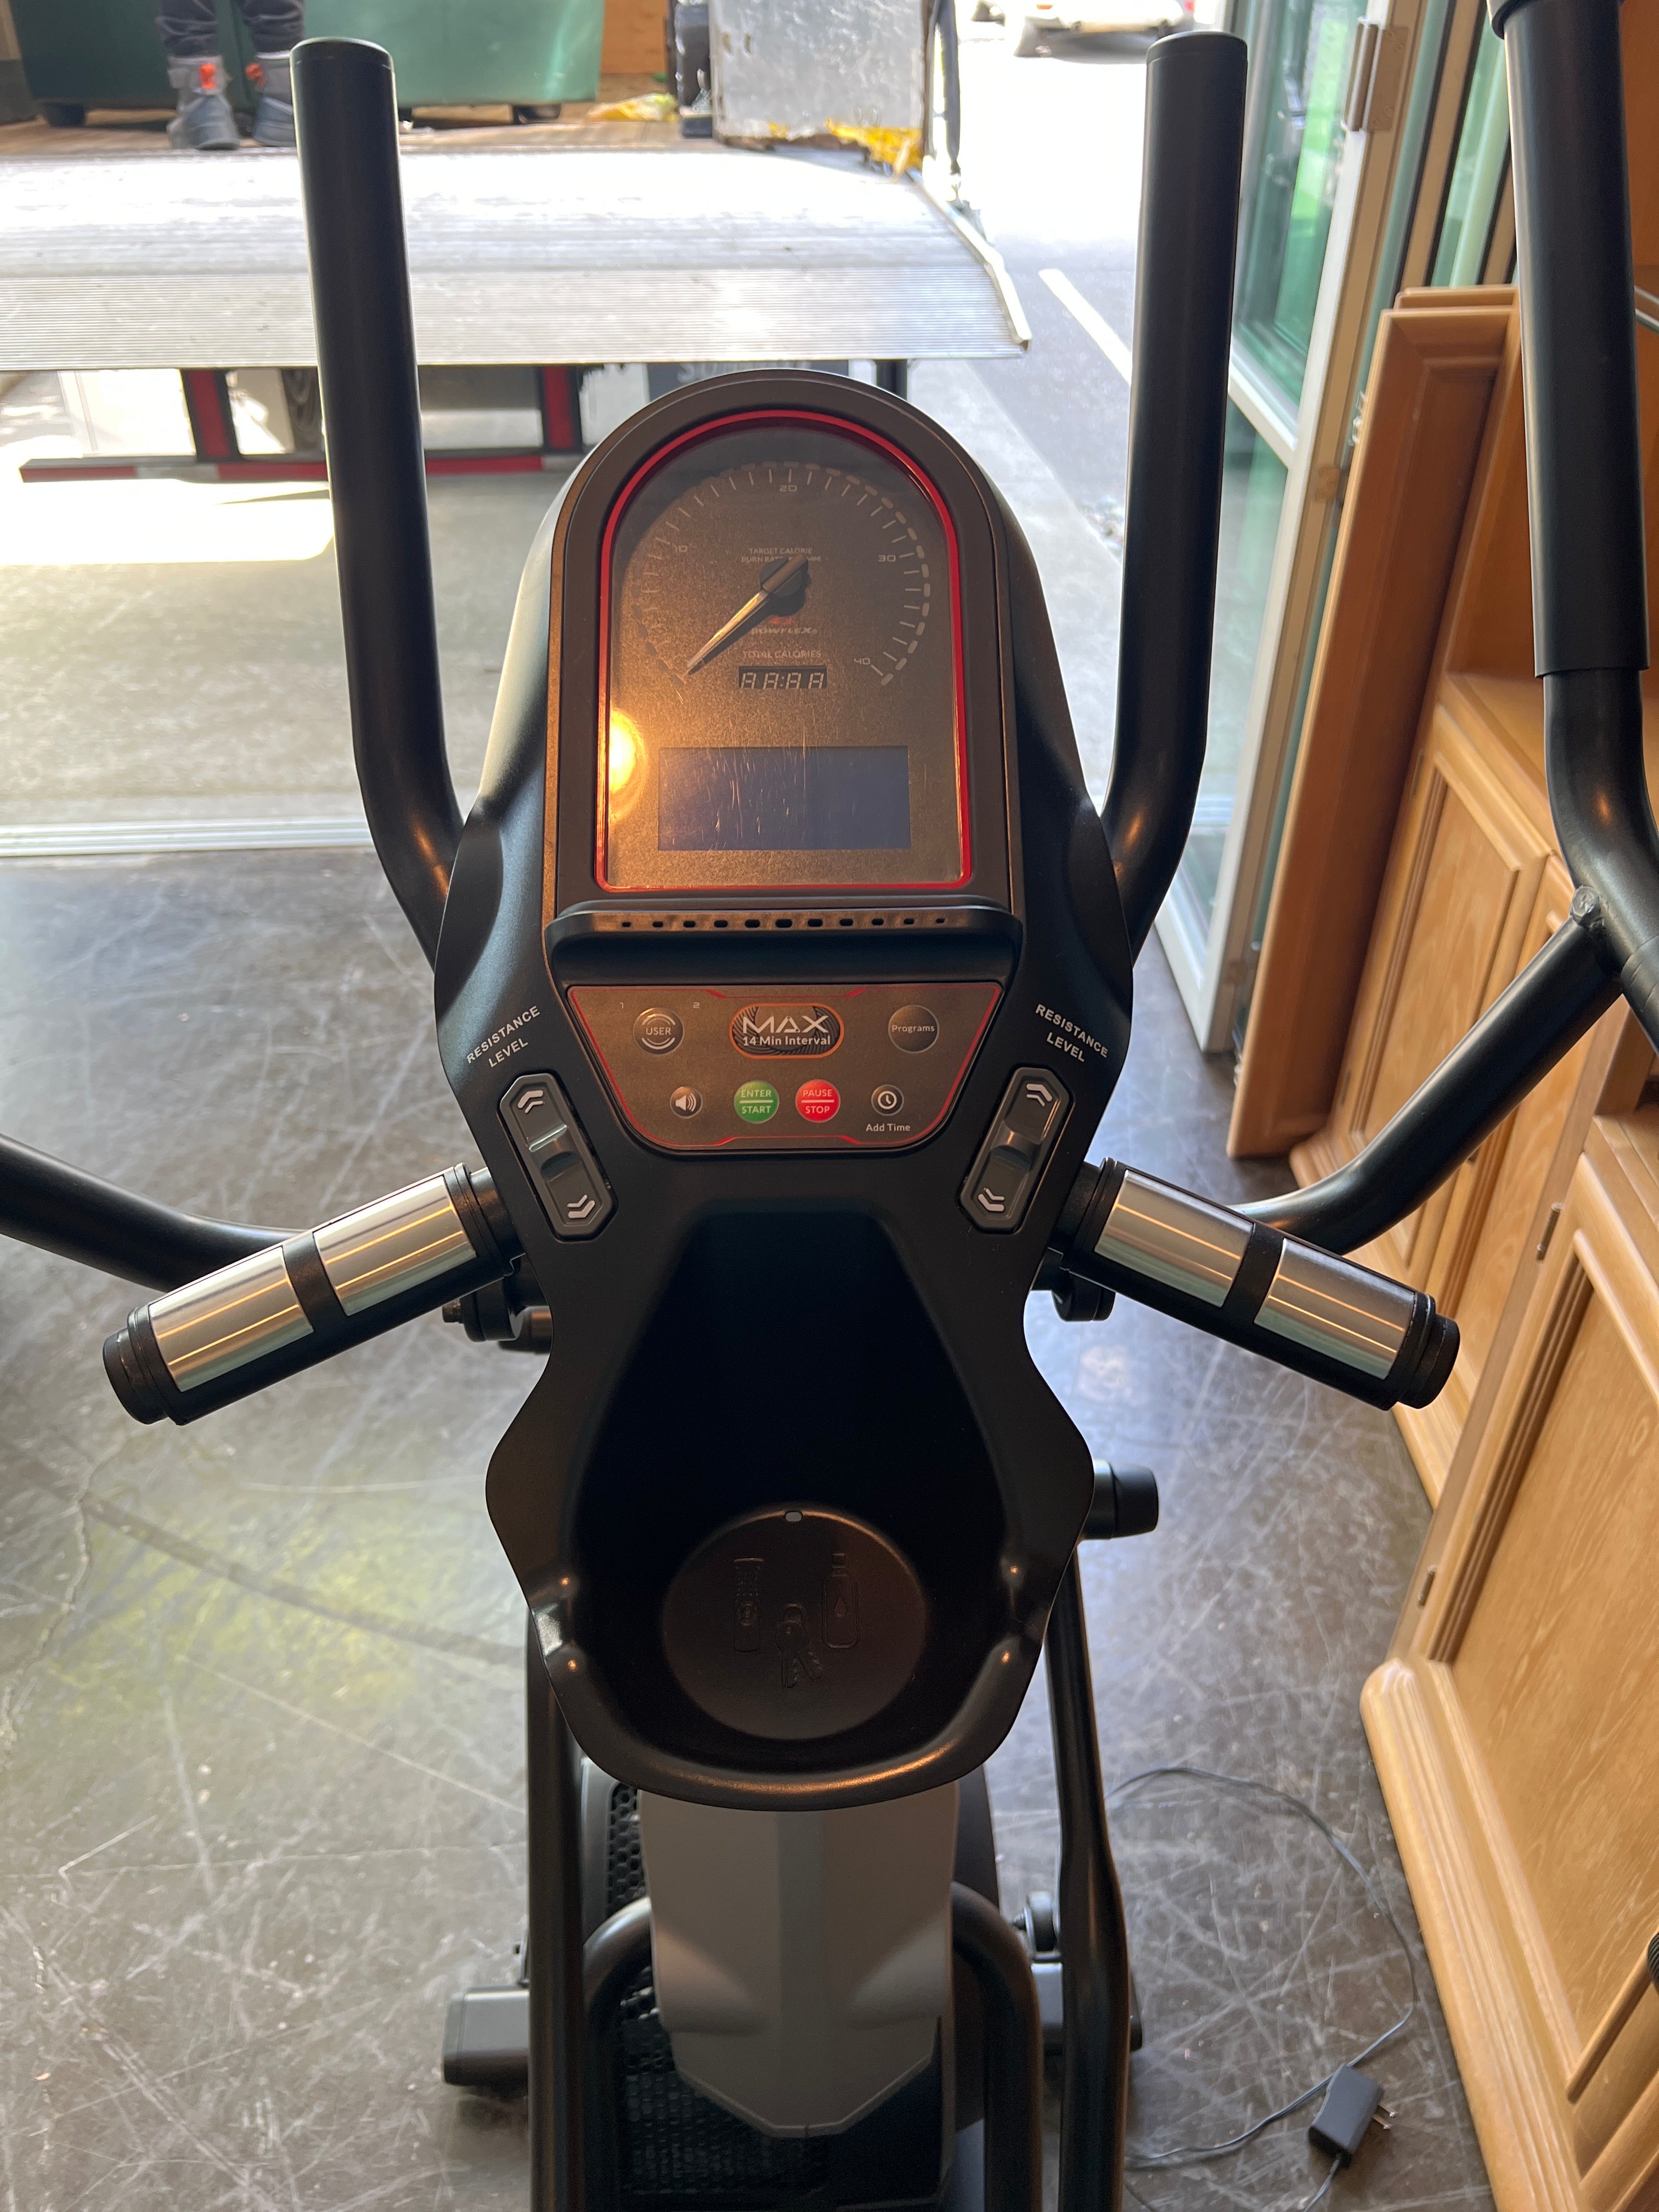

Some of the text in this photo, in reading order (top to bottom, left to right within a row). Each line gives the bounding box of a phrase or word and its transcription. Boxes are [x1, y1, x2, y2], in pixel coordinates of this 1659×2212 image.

[672, 544, 688, 552] 10
[742, 1015, 829, 1034] MAX
[891, 1024, 935, 1034] Programs
[466, 1005, 540, 1064] RESISTANCE
[646, 1026, 672, 1036] USER
[1035, 1003, 1108, 1058] RESISTANCE
[742, 1036, 831, 1046] 14 Min Interval
[1046, 1032, 1085, 1062] LEVEL
[488, 1038, 528, 1068] LEVEL
[741, 1090, 772, 1098] ENTER
[803, 1089, 832, 1097] PAUSE
[741, 1105, 772, 1114] START
[805, 1105, 830, 1114] STOP
[866, 1123, 911, 1132] Add Time
